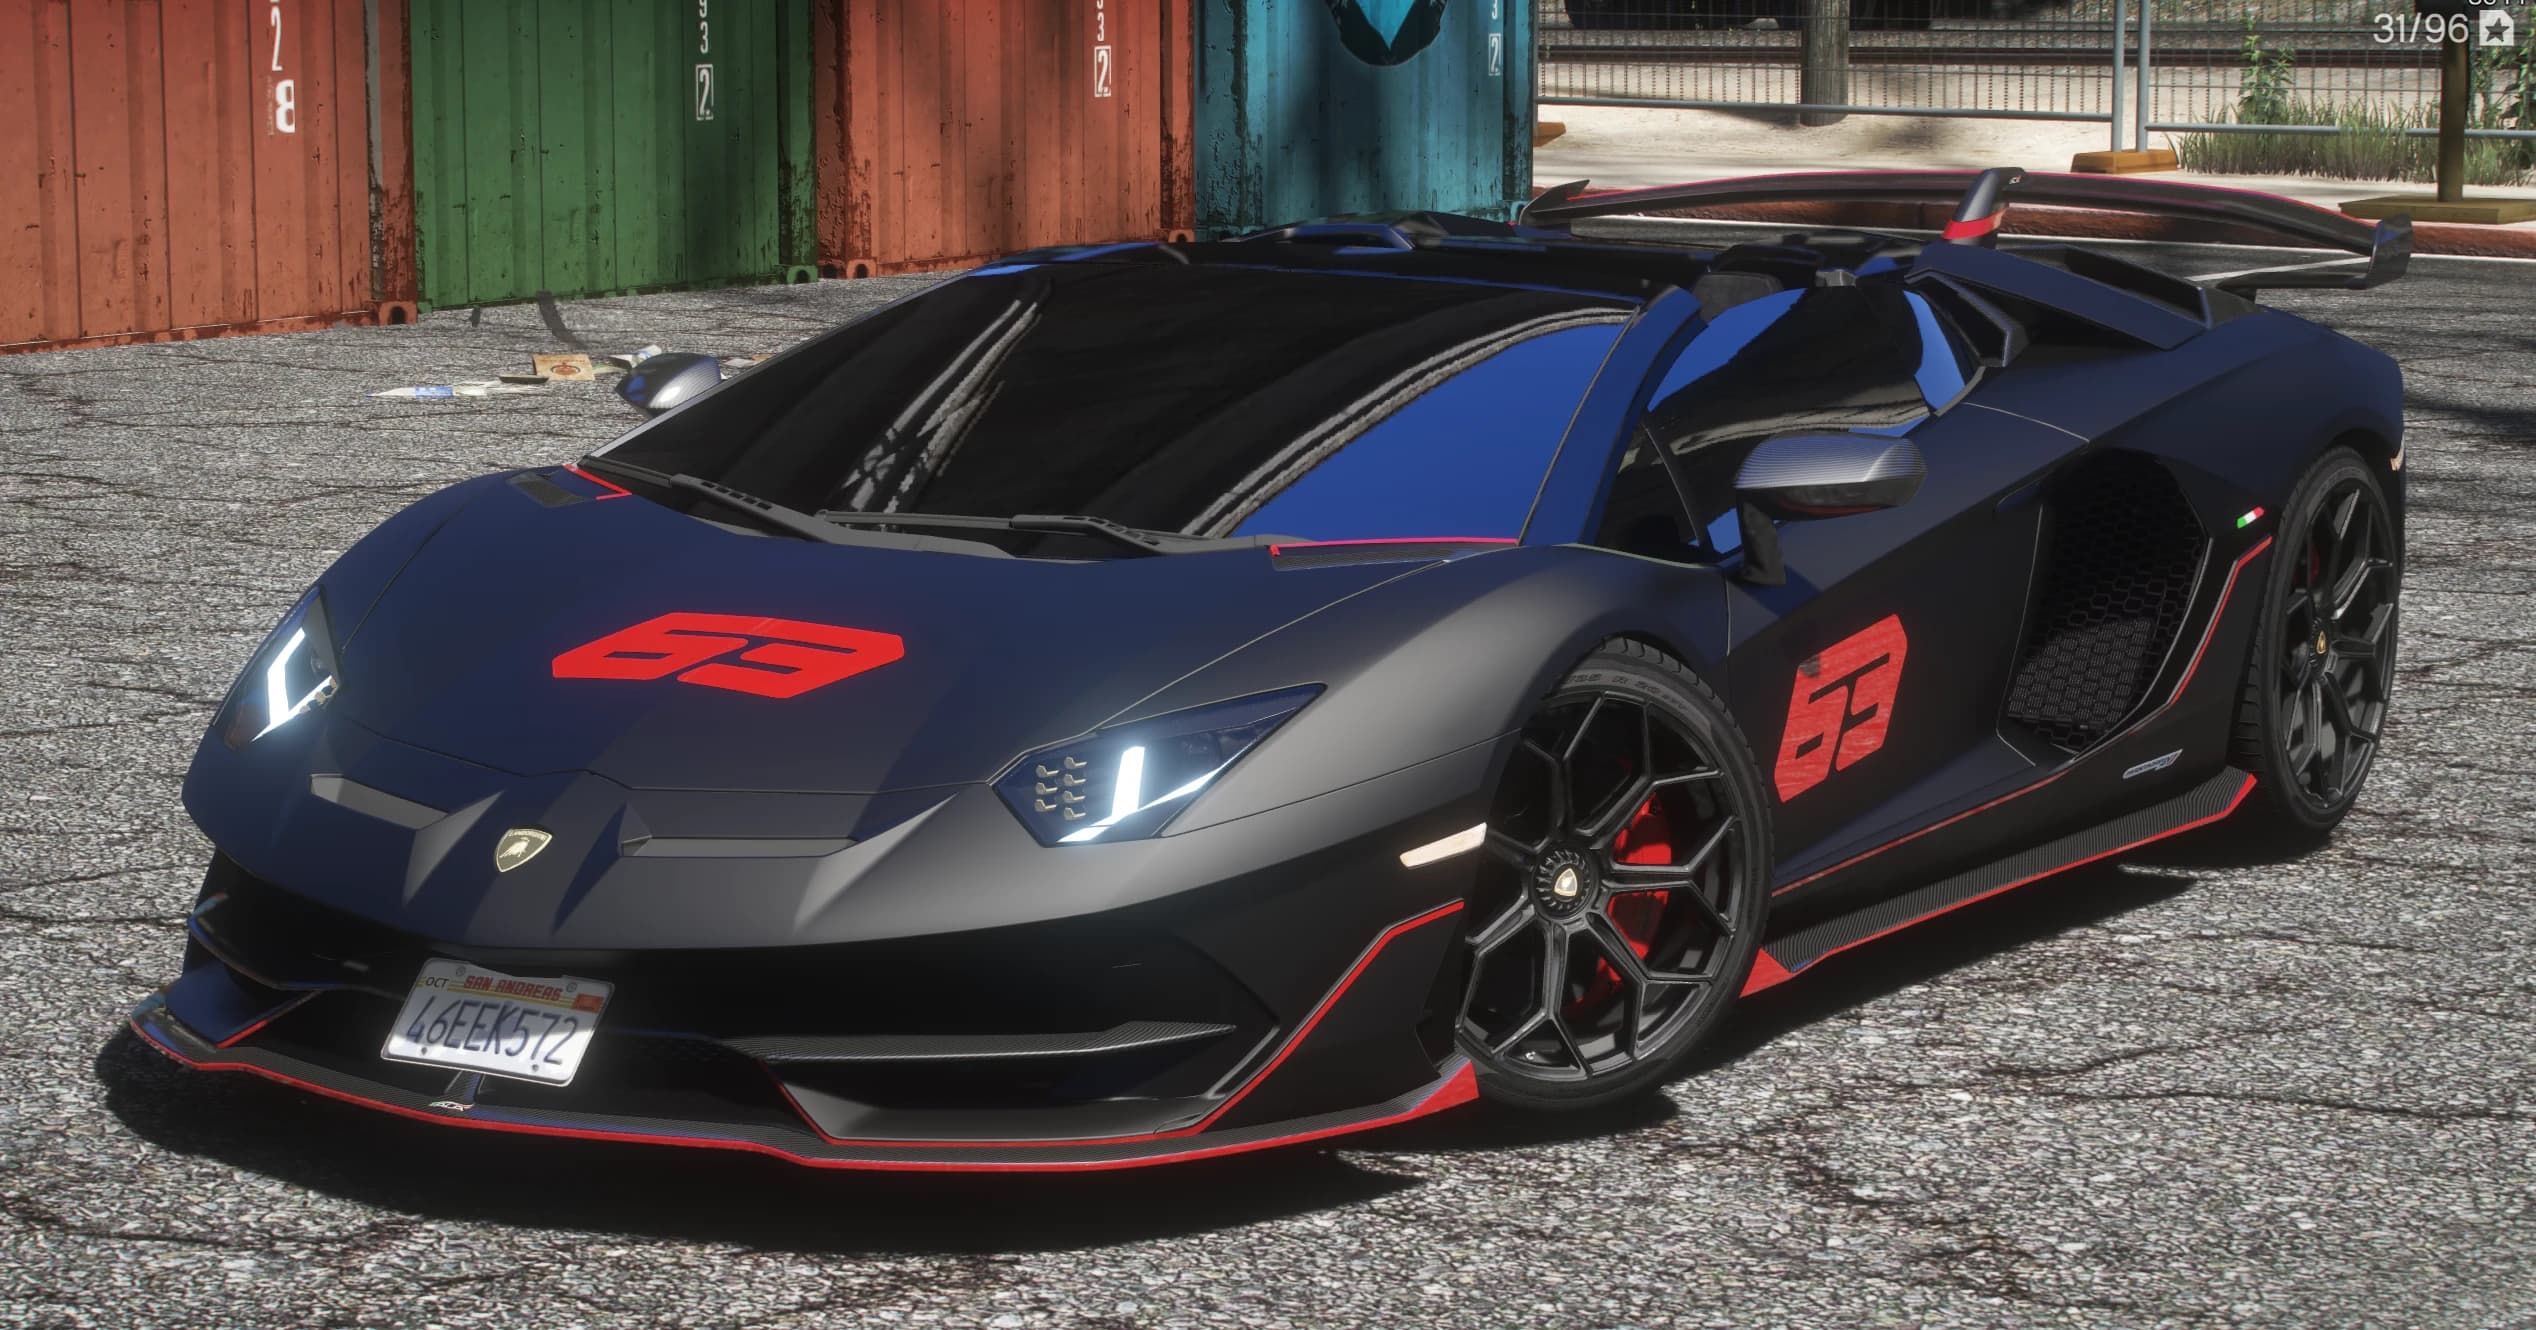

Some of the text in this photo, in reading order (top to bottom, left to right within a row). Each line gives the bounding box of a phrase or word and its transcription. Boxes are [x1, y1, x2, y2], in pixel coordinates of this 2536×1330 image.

[1096, 0, 1104, 41] 3
[552, 612, 905, 699] 63
[1774, 613, 1908, 804] 63
[425, 976, 450, 989] OCT
[463, 975, 563, 1001] SAN ANDREAS
[406, 995, 579, 1066] 46EEK572
